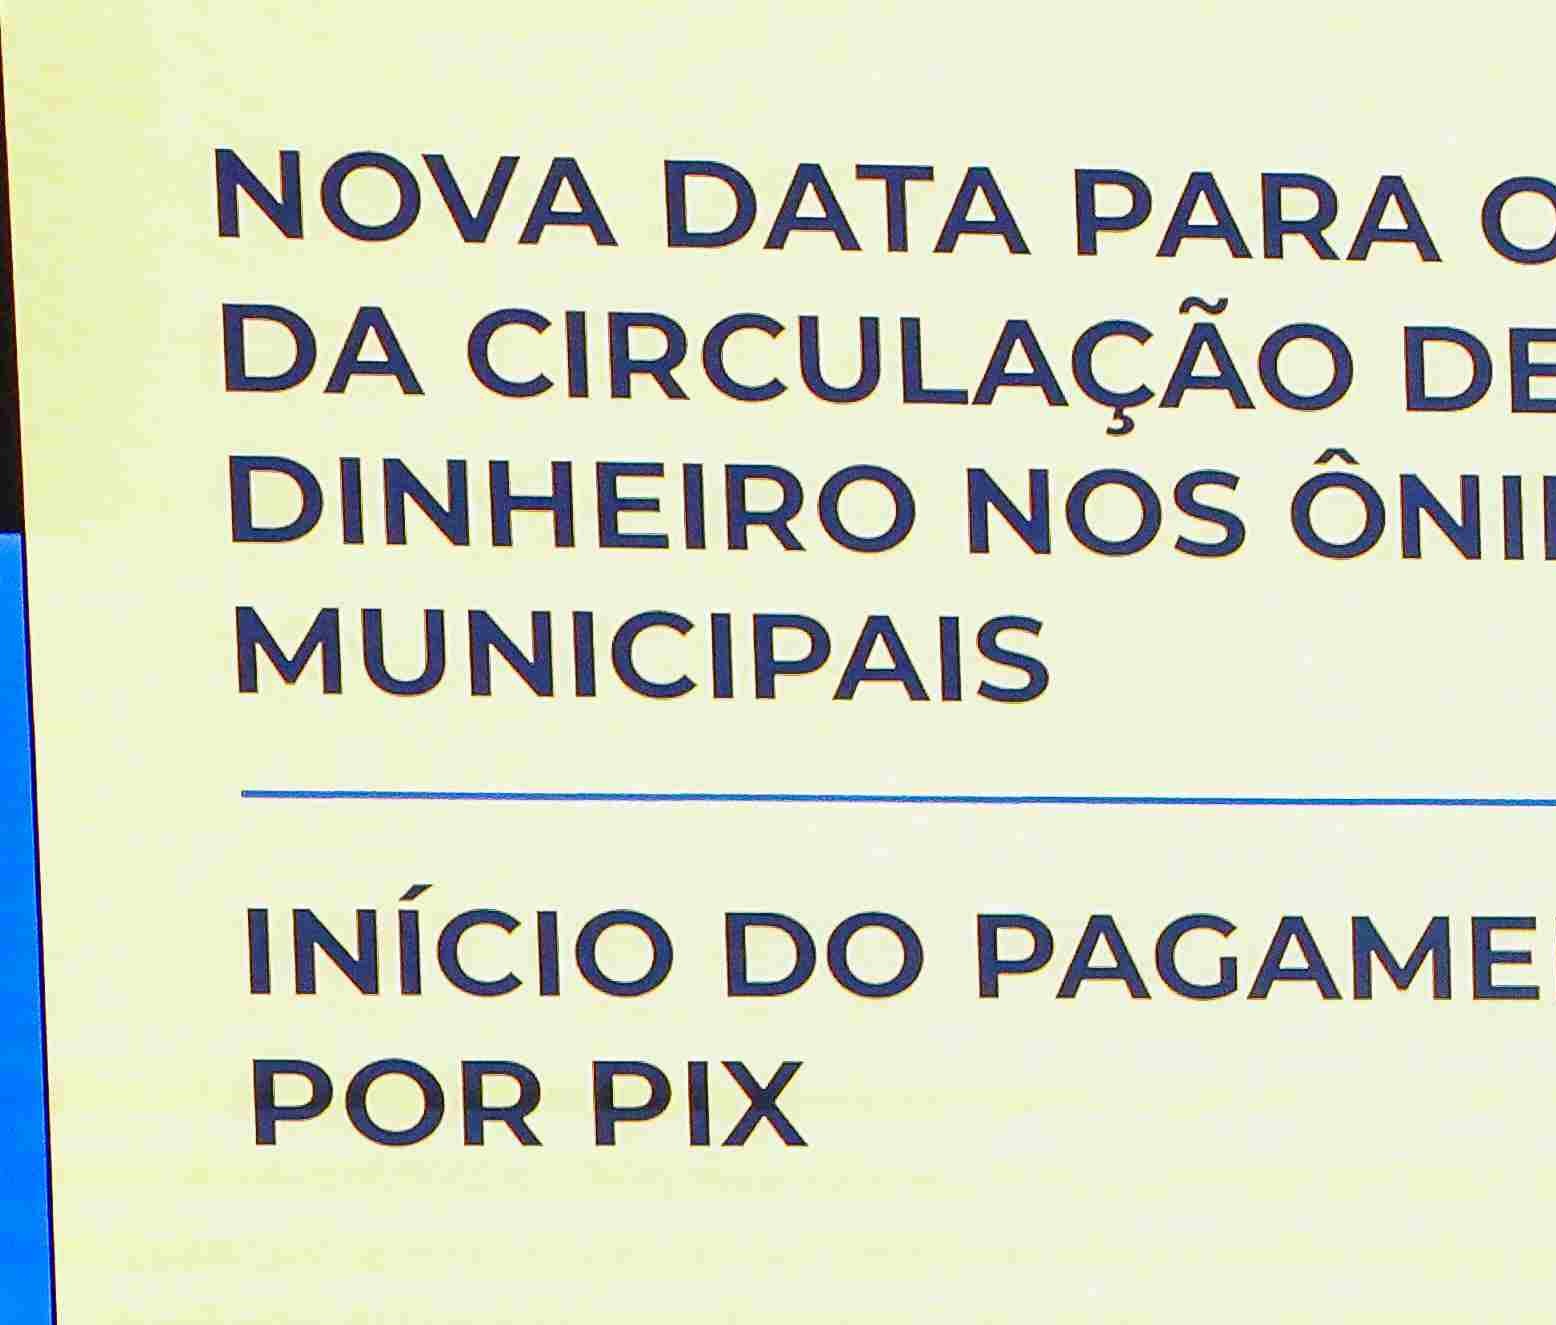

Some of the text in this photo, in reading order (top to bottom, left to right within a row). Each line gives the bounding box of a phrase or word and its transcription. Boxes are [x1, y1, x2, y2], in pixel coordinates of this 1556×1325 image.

[215, 149, 618, 246] NOVA
[664, 160, 1031, 254] DATA
[1075, 169, 1442, 262] PARA
[222, 304, 424, 395] DA
[468, 297, 1353, 436] CIRCULAÇÃO
[229, 456, 915, 553] DINHEIRO
[967, 468, 1245, 557] NOS
[236, 606, 1049, 702] MUNICIPAIS
[248, 885, 673, 997] INÍCIO
[725, 912, 923, 998] DO
[253, 1059, 808, 1146] POR PIX
